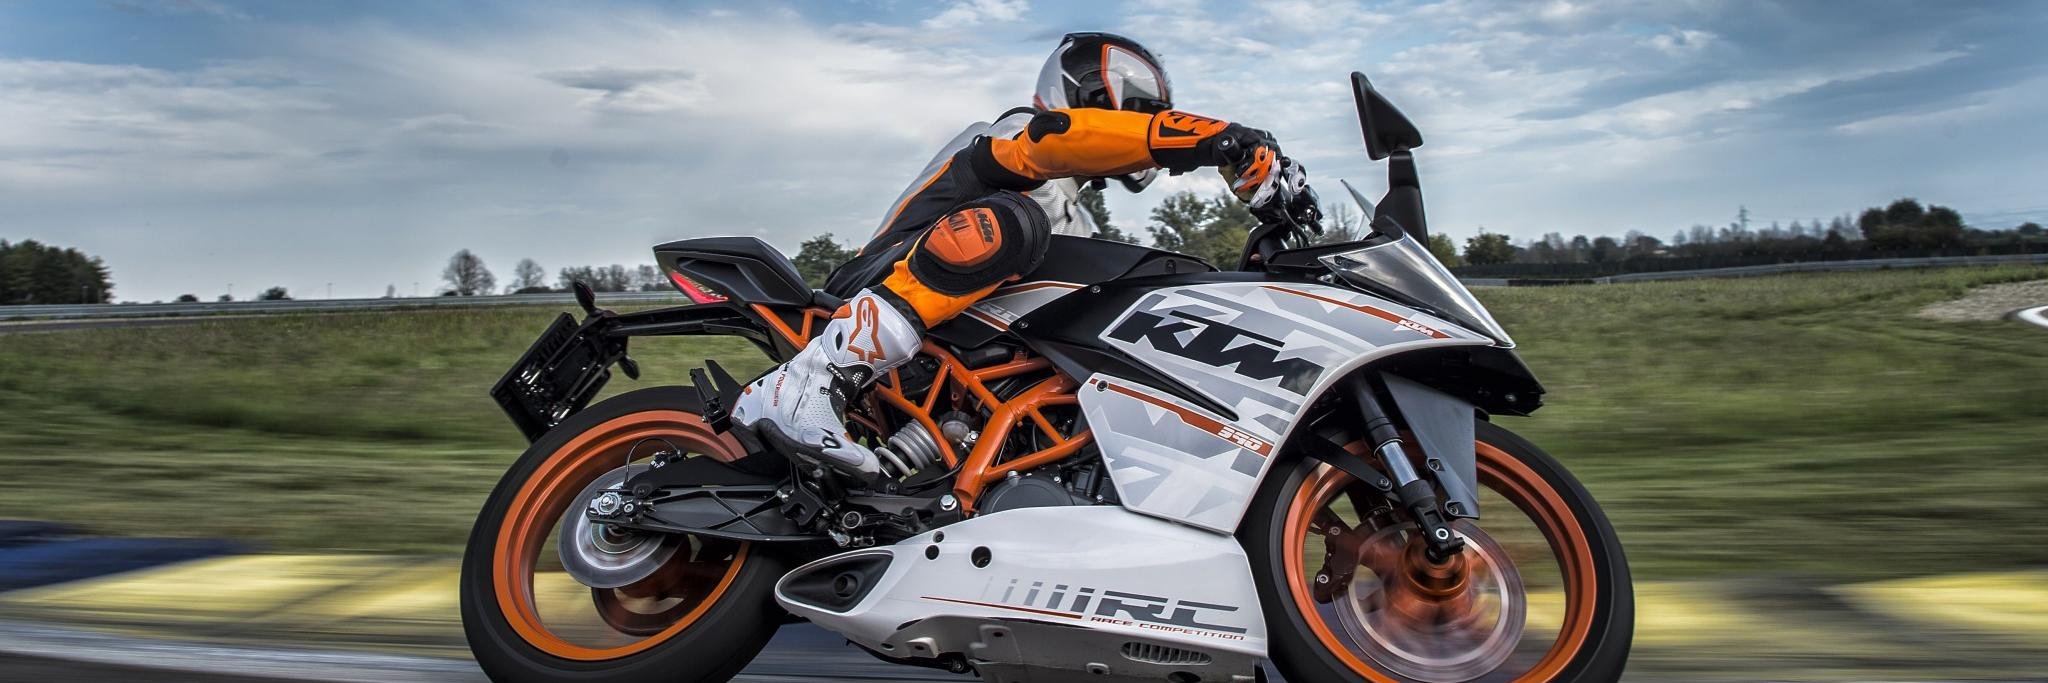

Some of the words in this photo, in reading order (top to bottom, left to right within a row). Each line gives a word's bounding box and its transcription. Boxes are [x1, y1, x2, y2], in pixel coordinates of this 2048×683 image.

[1398, 319, 1434, 337] KTM
[1107, 310, 1325, 397] KTM
[1217, 426, 1263, 451] 390
[1095, 590, 1247, 634] RC
[1091, 616, 1133, 626] RACE
[1139, 623, 1245, 641] COMPETITION
